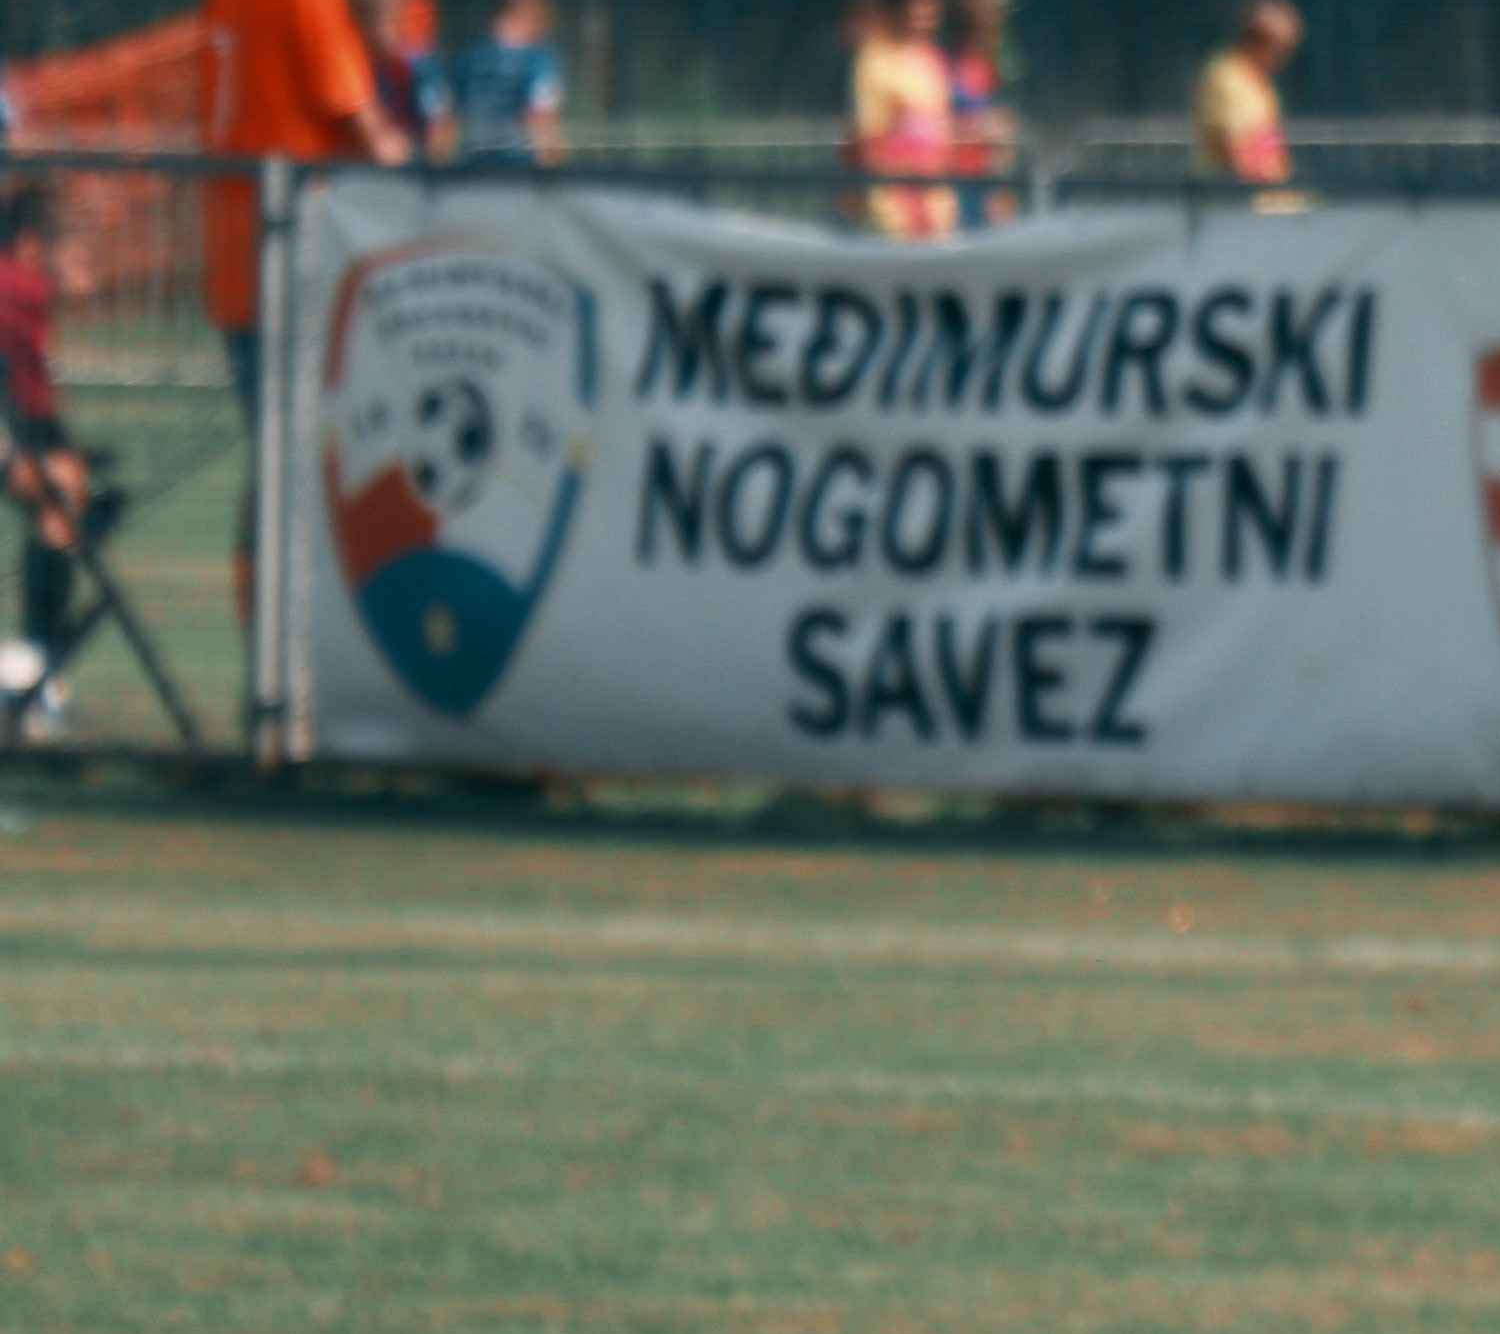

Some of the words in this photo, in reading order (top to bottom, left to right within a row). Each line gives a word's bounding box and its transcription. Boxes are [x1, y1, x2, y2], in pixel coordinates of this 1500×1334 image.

[637, 274, 1377, 418] MEĐIMURSKI
[636, 436, 1342, 584] NOGOMETNI
[785, 605, 1158, 745] SAVEZ
